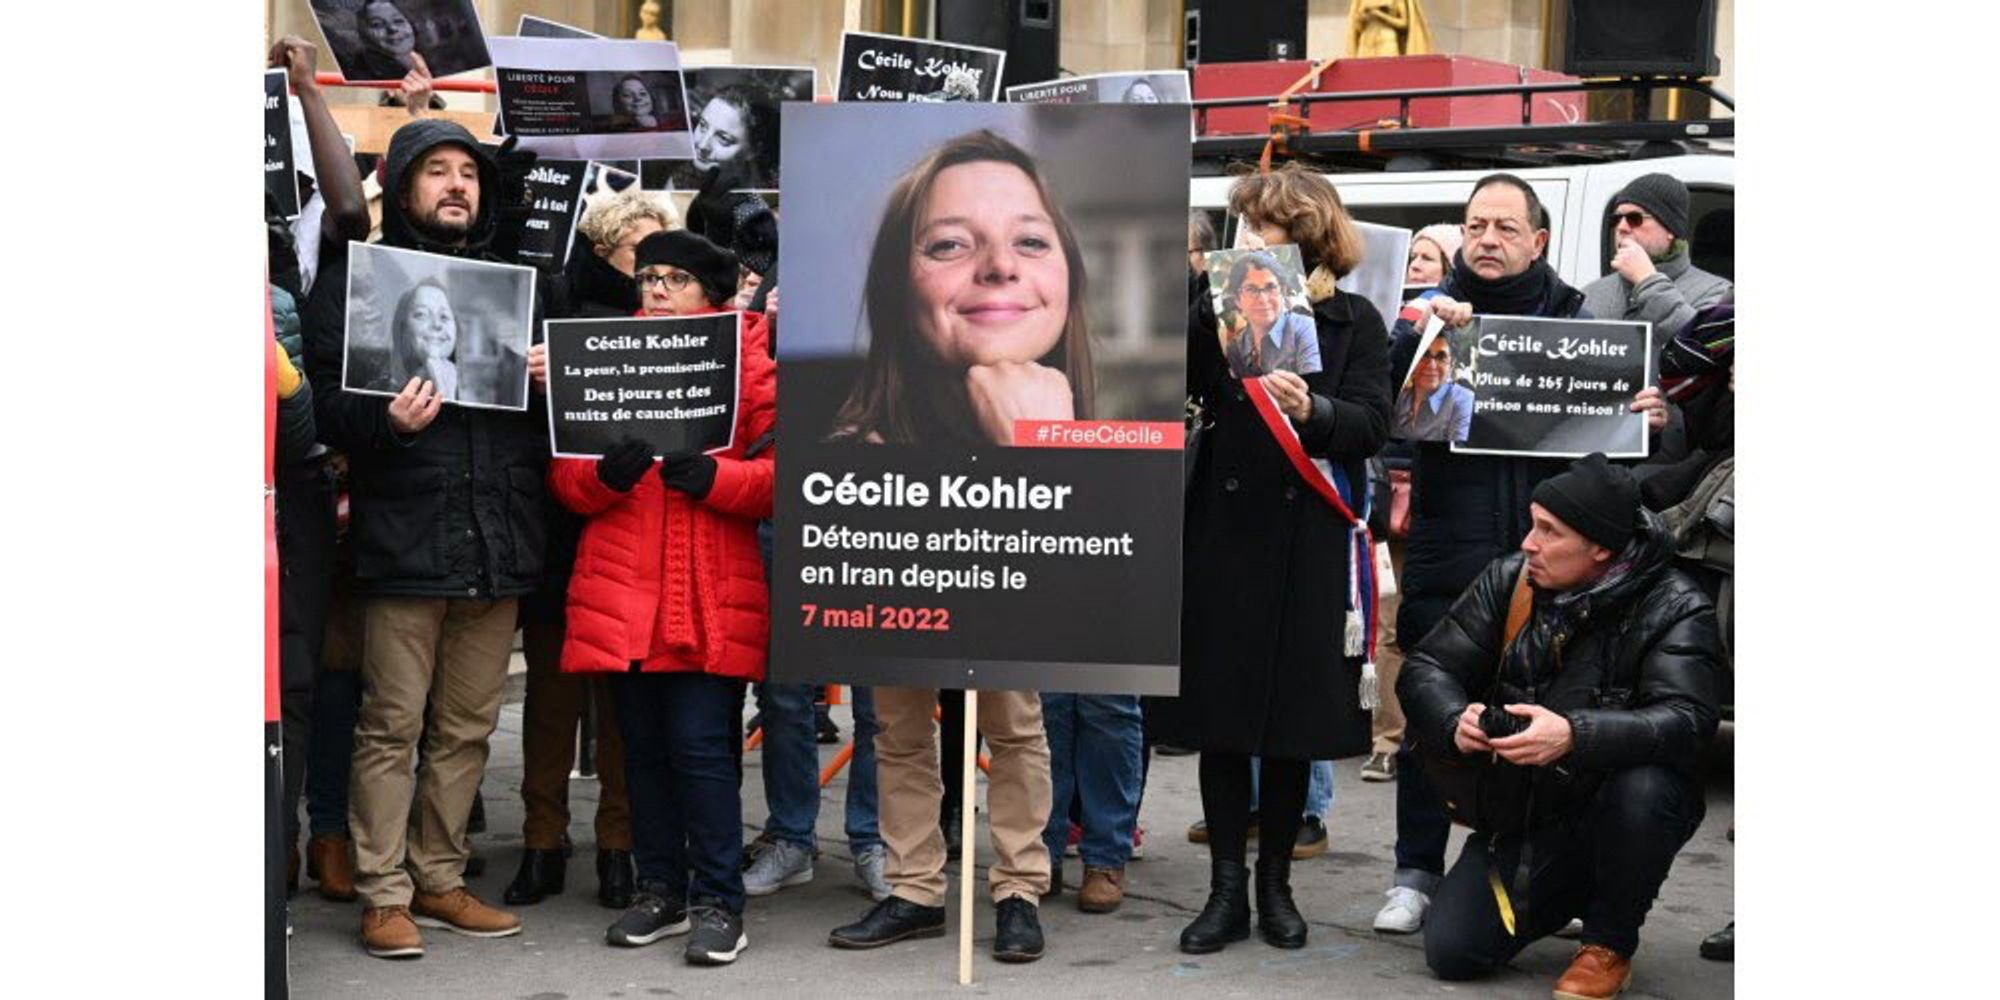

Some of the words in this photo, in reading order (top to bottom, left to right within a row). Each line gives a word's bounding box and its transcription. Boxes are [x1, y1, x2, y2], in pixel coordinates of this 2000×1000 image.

[857, 49, 912, 70] Cécile
[914, 57, 983, 78] Kohler
[547, 74, 576, 84] POUR
[857, 84, 903, 100] Nous
[1020, 87, 1058, 101] LIBERTÉ
[1060, 83, 1088, 95] POUR
[524, 166, 571, 185] ohler
[585, 335, 642, 351] Cécile
[645, 334, 709, 350] Kohler
[1478, 333, 1544, 357] Cécile
[1547, 336, 1628, 360] Kohler
[564, 365, 581, 376] La
[584, 365, 621, 378] peur,
[623, 363, 636, 375] la
[1516, 373, 1533, 388] de
[1537, 375, 1563, 390] 265
[1566, 376, 1608, 394] jours
[1612, 378, 1630, 393] de
[584, 388, 615, 402] Des
[617, 387, 664, 403] jours
[666, 387, 684, 400] et
[686, 385, 712, 398] des
[564, 407, 609, 421] nuits
[612, 407, 632, 420] de
[635, 403, 727, 420] cauchemars
[1474, 397, 1521, 414] prison
[1526, 402, 1561, 413] sans
[1566, 402, 1614, 416] raison
[1037, 424, 1163, 445] #FreeCécile
[802, 472, 930, 508] Cécile
[940, 475, 1072, 511] Kohler
[802, 524, 919, 552] Détenue
[926, 528, 1133, 556] arbitrairement
[801, 565, 834, 584] en
[842, 562, 894, 587] Iran
[900, 564, 996, 593] depuis
[1002, 566, 1027, 590] le
[801, 605, 817, 628] 7
[823, 605, 873, 628] mai
[880, 608, 950, 631] 2022
